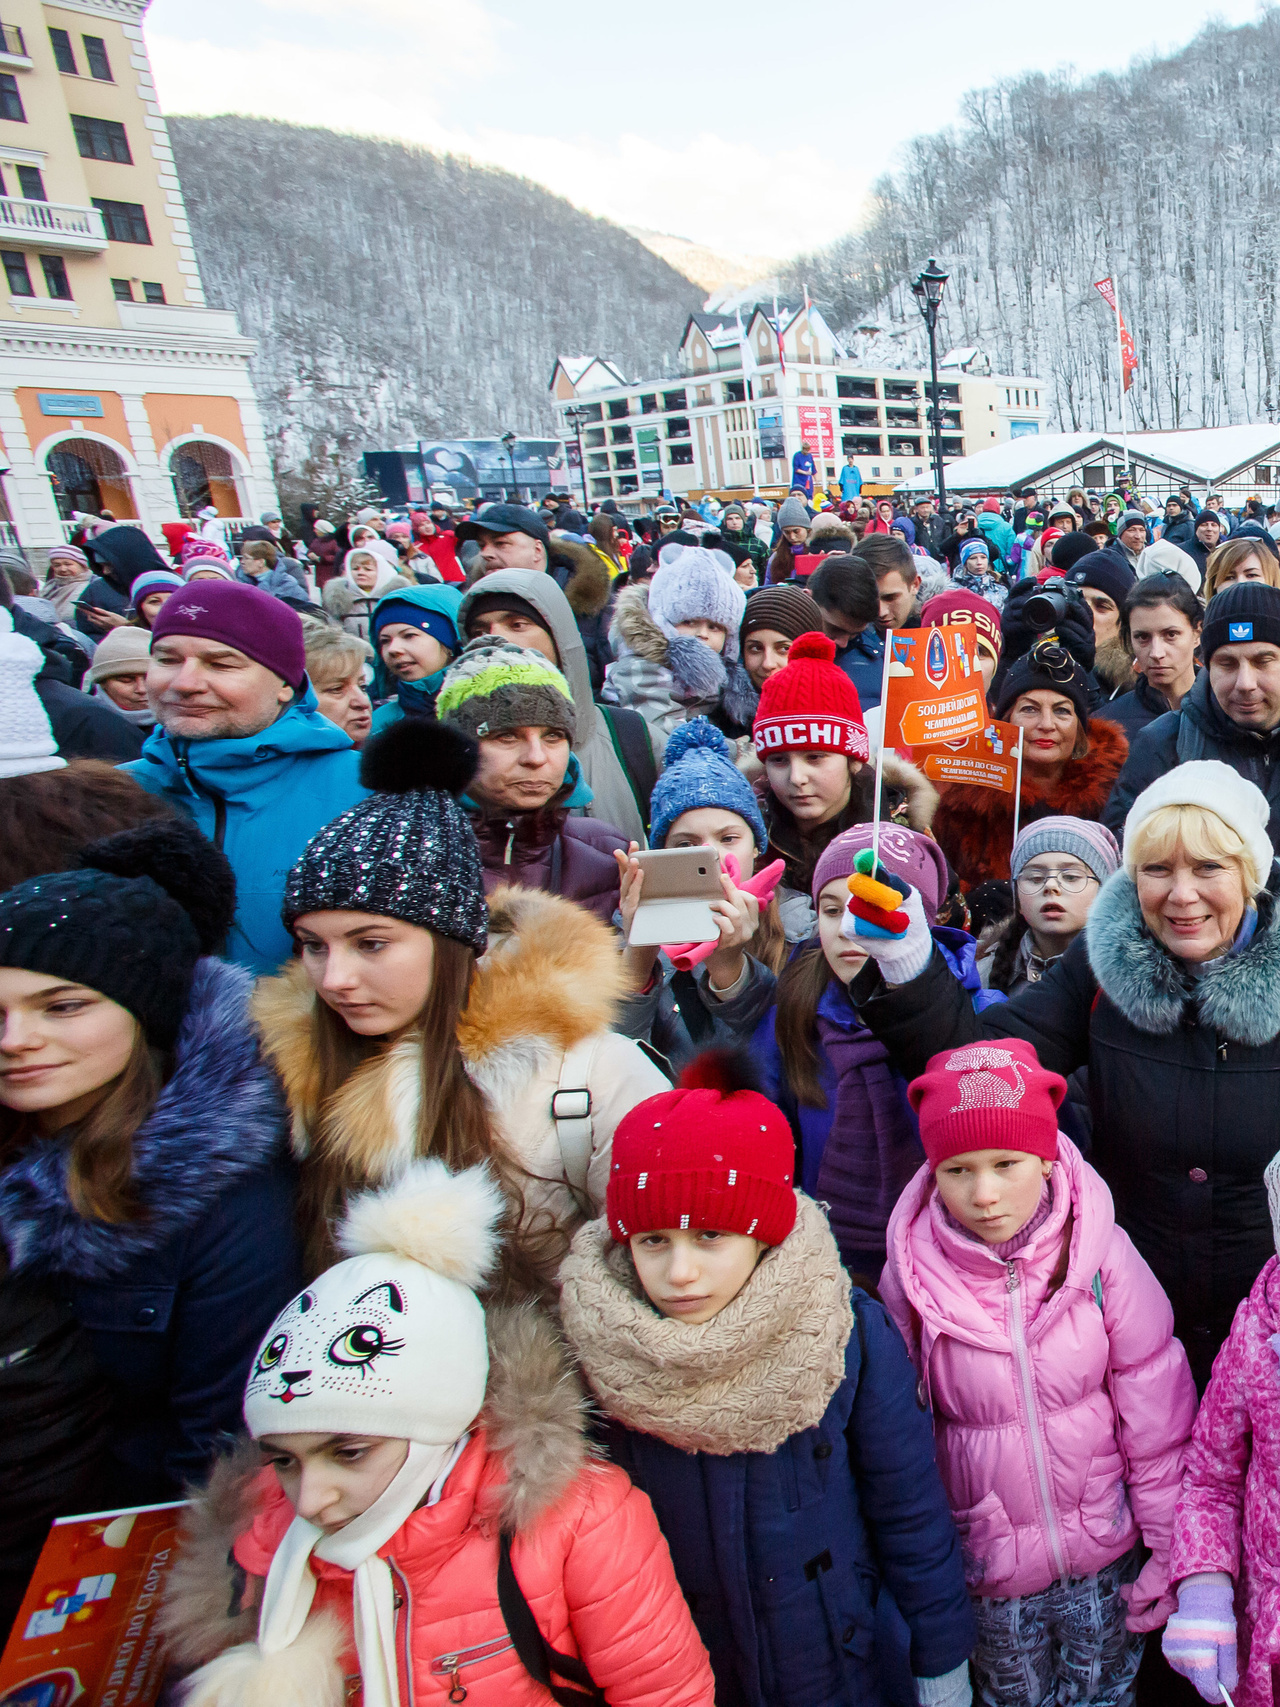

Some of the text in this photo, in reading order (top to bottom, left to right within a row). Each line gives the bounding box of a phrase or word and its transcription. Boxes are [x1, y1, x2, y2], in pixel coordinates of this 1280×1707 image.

[917, 704, 937, 717] 500
[937, 698, 957, 716] ДНЕЙ
[956, 698, 964, 711] ДО
[754, 723, 840, 752] SOCHI
[935, 757, 951, 765] 500
[952, 759, 974, 767] ДНЕЙ
[974, 761, 985, 769] ДО
[135, 1548, 171, 1611] СТАРТА
[125, 1613, 146, 1638] ДО
[107, 1640, 136, 1686] ДНЕЙ
